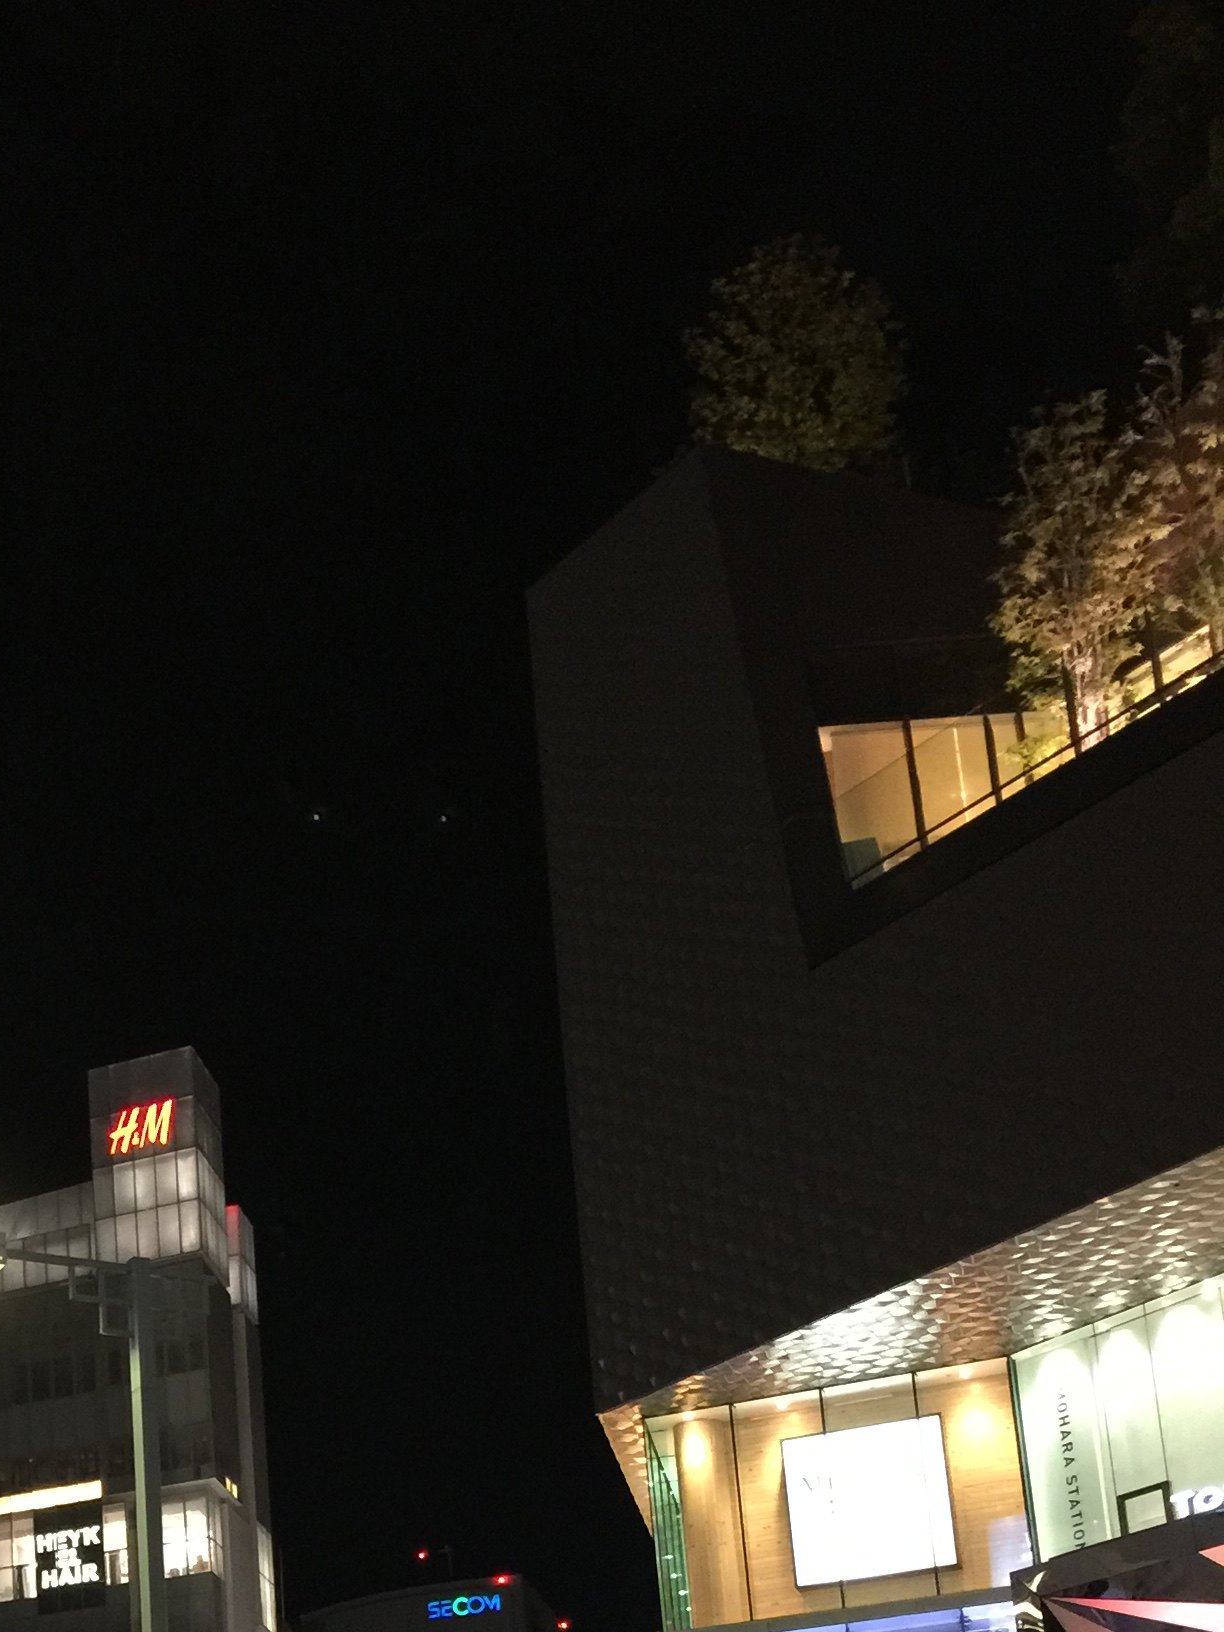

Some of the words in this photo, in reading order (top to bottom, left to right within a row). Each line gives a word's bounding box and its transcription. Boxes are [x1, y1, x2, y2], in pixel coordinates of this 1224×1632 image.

[109, 1098, 173, 1155] H&M
[41, 1563, 99, 1588] HAIR
[427, 1594, 502, 1619] SECOM
